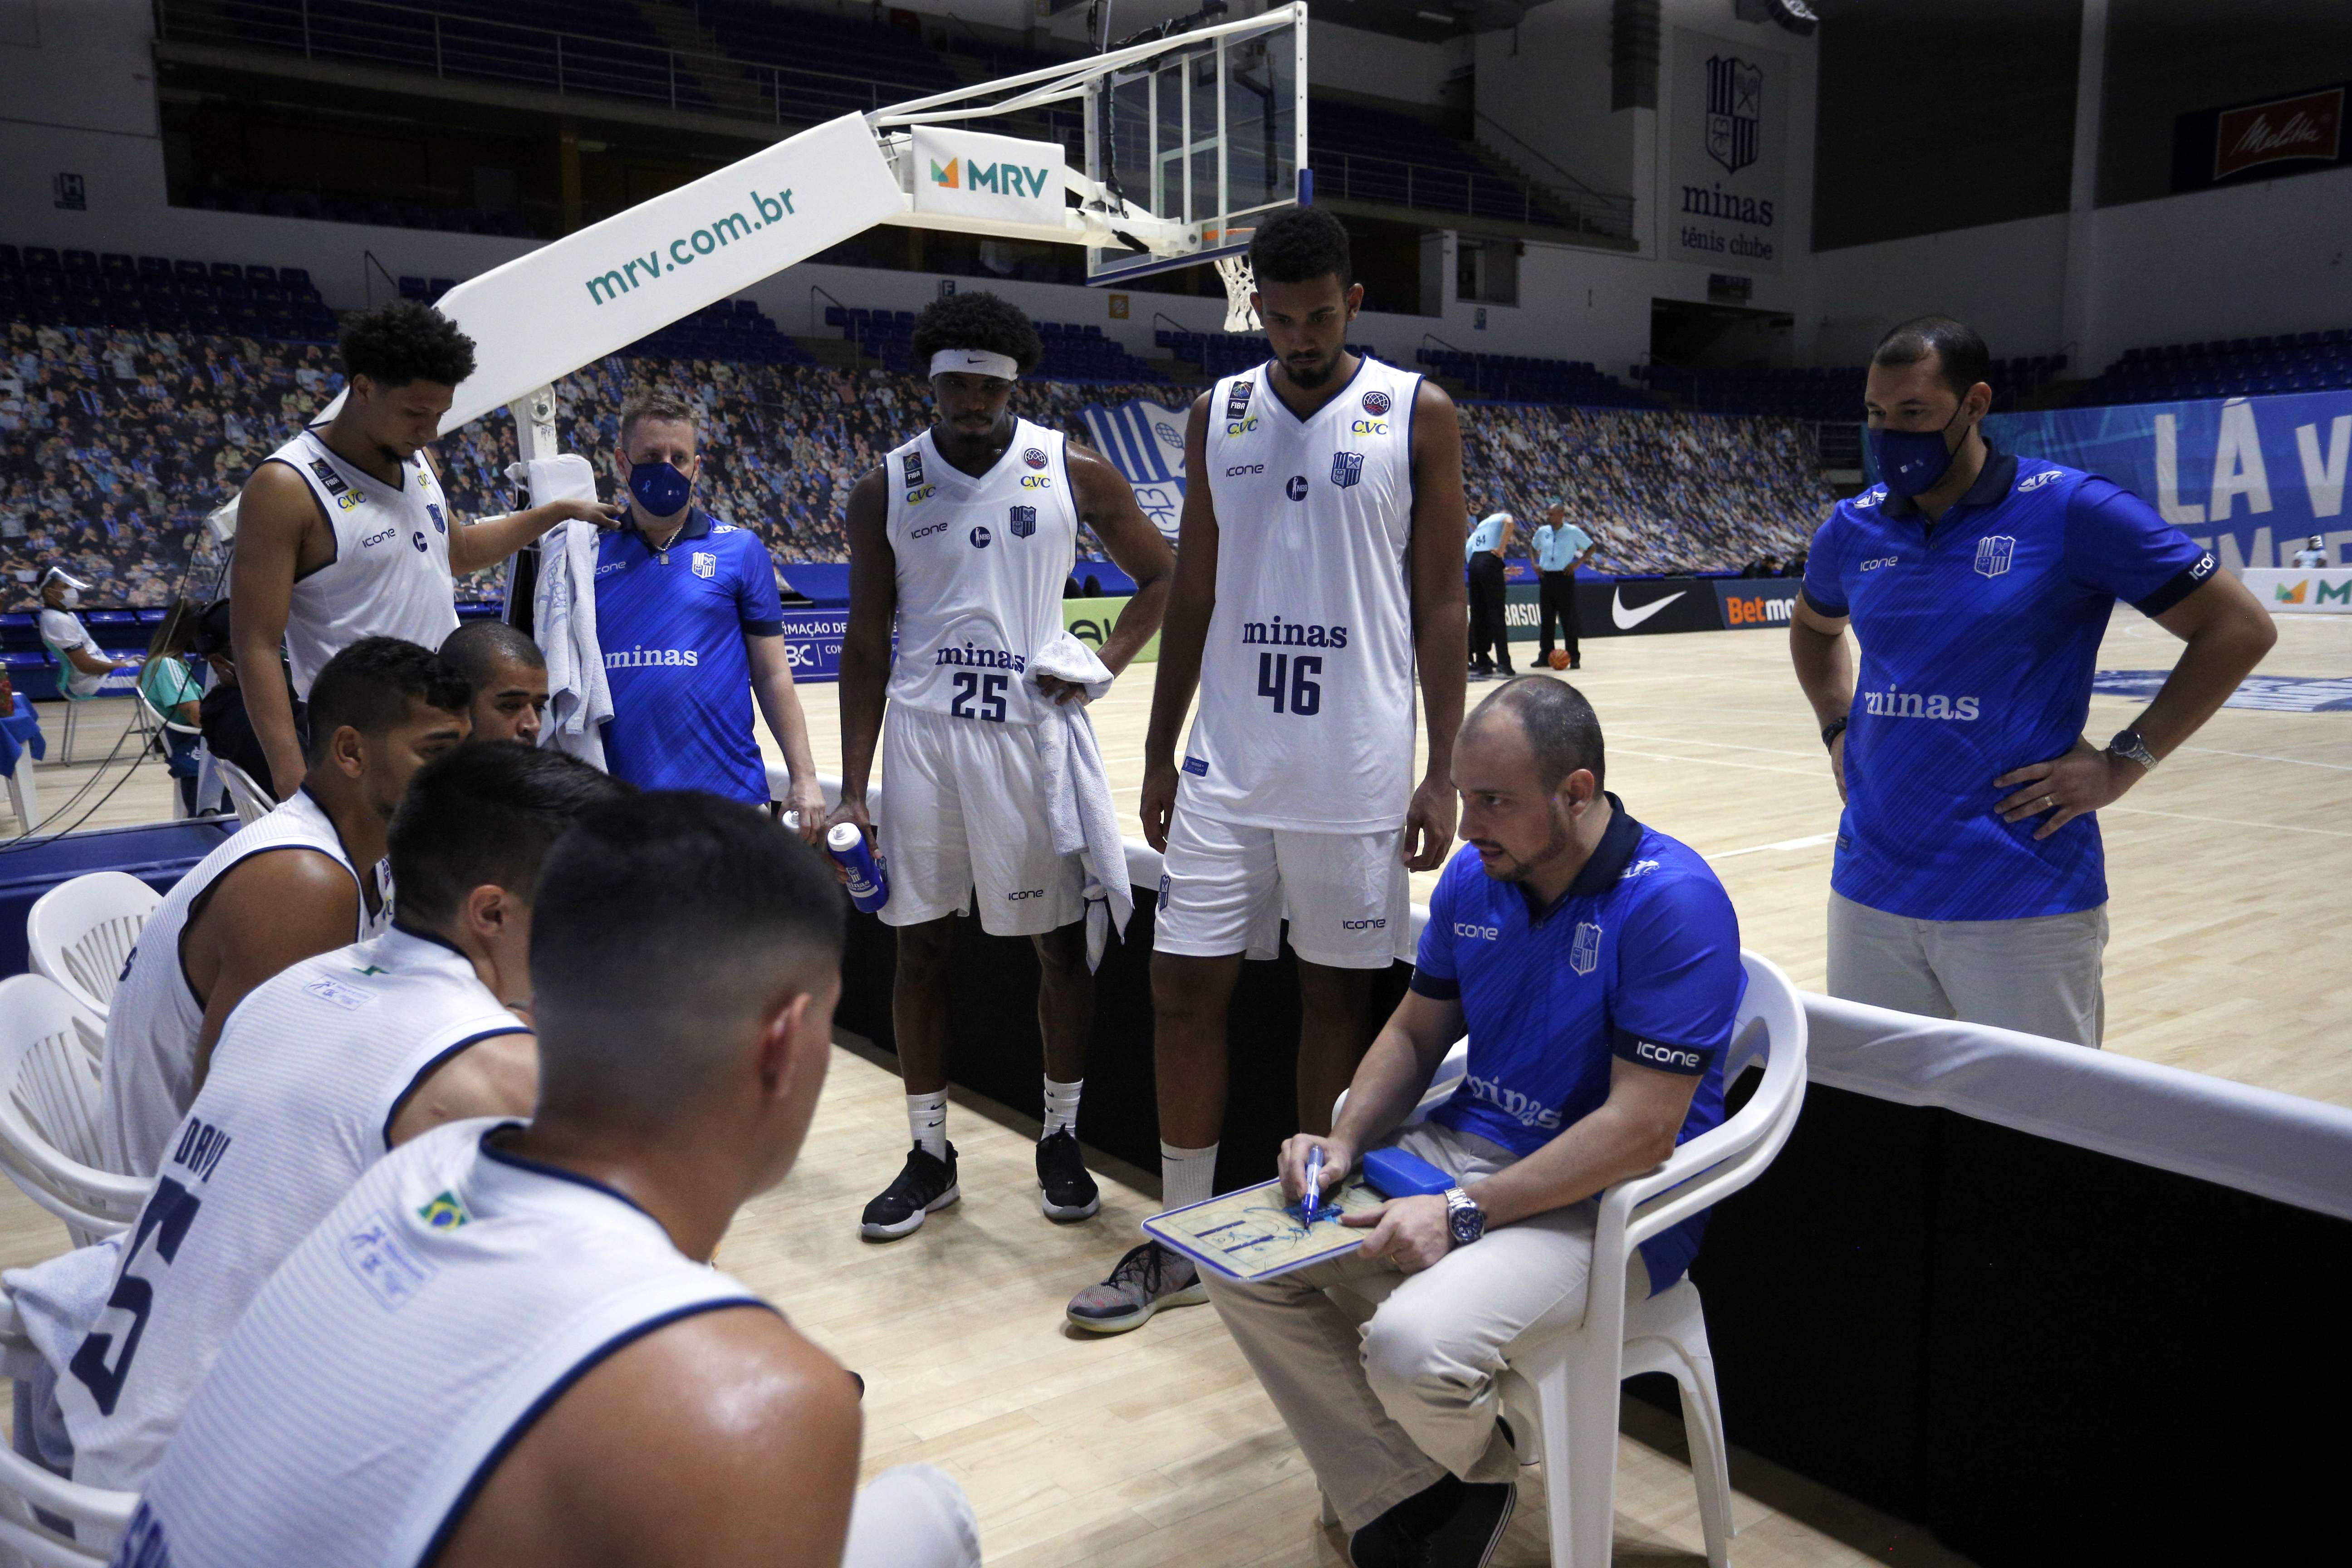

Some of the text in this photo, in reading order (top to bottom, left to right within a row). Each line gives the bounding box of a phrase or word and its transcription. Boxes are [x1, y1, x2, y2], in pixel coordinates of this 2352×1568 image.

[968, 159, 1049, 199] MRV
[1682, 182, 1774, 227] minas
[586, 188, 795, 305] mrv.com.br
[1730, 233, 1772, 260] clube
[1227, 419, 1258, 434] CVC
[1351, 420, 1388, 435] CVC
[908, 471, 920, 480] FIBA
[2155, 397, 2273, 524] LA
[325, 477, 339, 487] FIBA
[906, 487, 936, 503] CVC
[1020, 476, 1051, 488] CVC
[338, 491, 367, 509] CVC
[1726, 596, 1798, 625] Betmo
[1243, 616, 1348, 649] minas
[605, 644, 698, 669] minas
[935, 642, 1025, 675] minas
[951, 671, 1008, 723] 25
[1258, 652, 1323, 716] 46
[1864, 683, 1980, 721] minas
[174, 1117, 232, 1183] DAVI
[69, 1175, 201, 1417] 5
